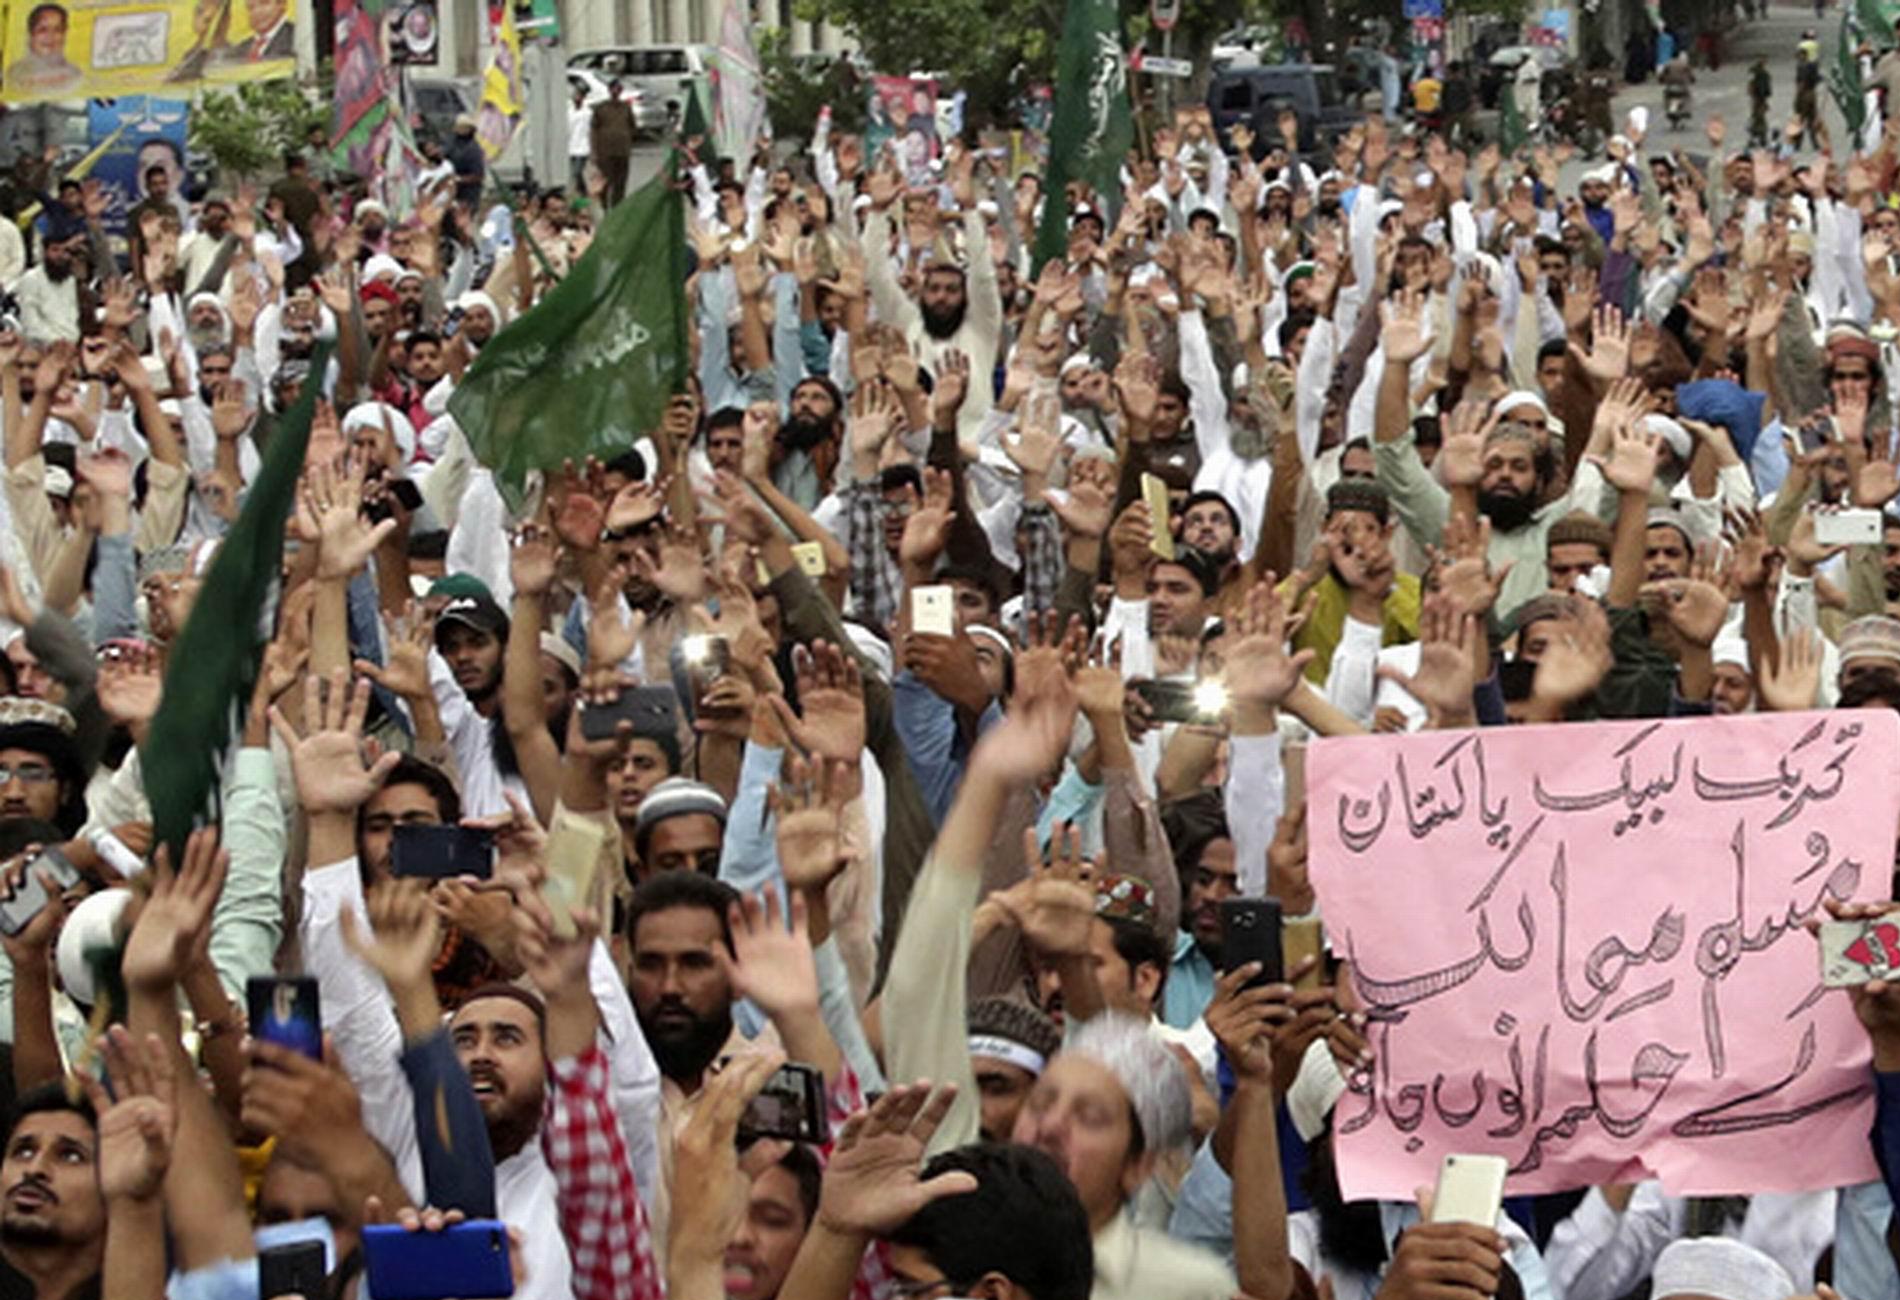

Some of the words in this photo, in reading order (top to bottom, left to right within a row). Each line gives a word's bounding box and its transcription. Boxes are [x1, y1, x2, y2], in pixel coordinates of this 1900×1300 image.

[1337, 732, 1510, 852] پاکستان
[1532, 722, 1685, 836] لبیک
[1693, 718, 1865, 831] تحریک
